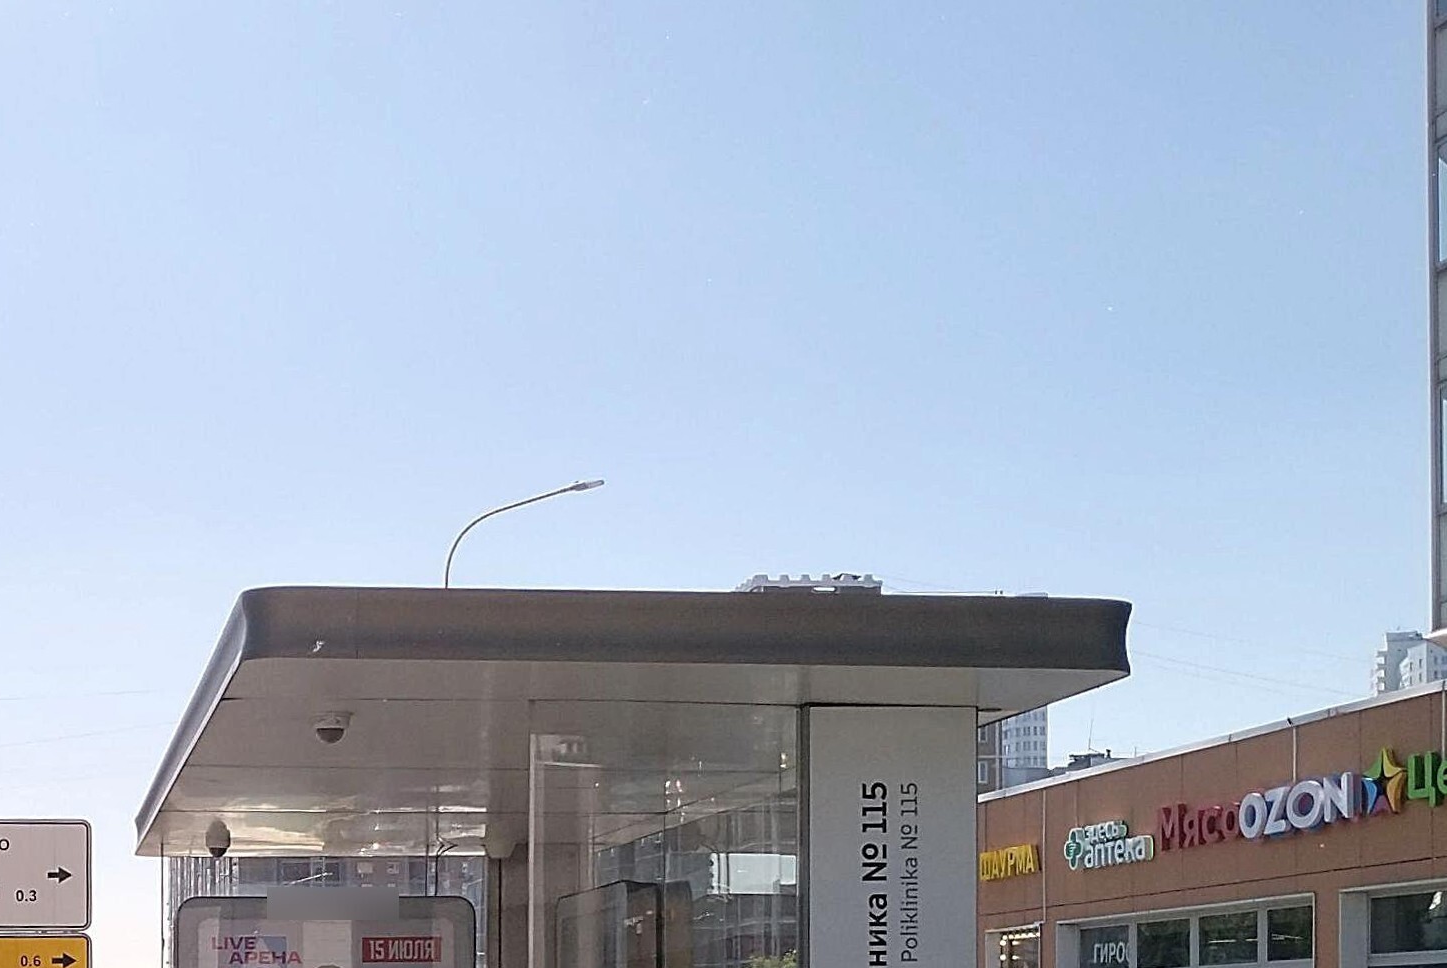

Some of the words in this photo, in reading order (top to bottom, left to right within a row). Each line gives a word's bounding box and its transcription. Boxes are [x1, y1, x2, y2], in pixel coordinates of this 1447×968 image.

[862, 781, 888, 833] 115
[900, 782, 918, 817] 115
[1239, 771, 1353, 838] OZON
[862, 842, 888, 881] №
[979, 845, 1037, 881] ШАУРМА
[1084, 837, 1147, 869] аптека
[15, 890, 37, 902] 0.3
[900, 857, 918, 962] Poliklinika
[211, 936, 257, 950] LIVE
[229, 951, 302, 964] АРЕНА
[369, 940, 385, 957] 15
[389, 939, 435, 960] ИЮЛЯ
[20, 955, 41, 967] 0.6
